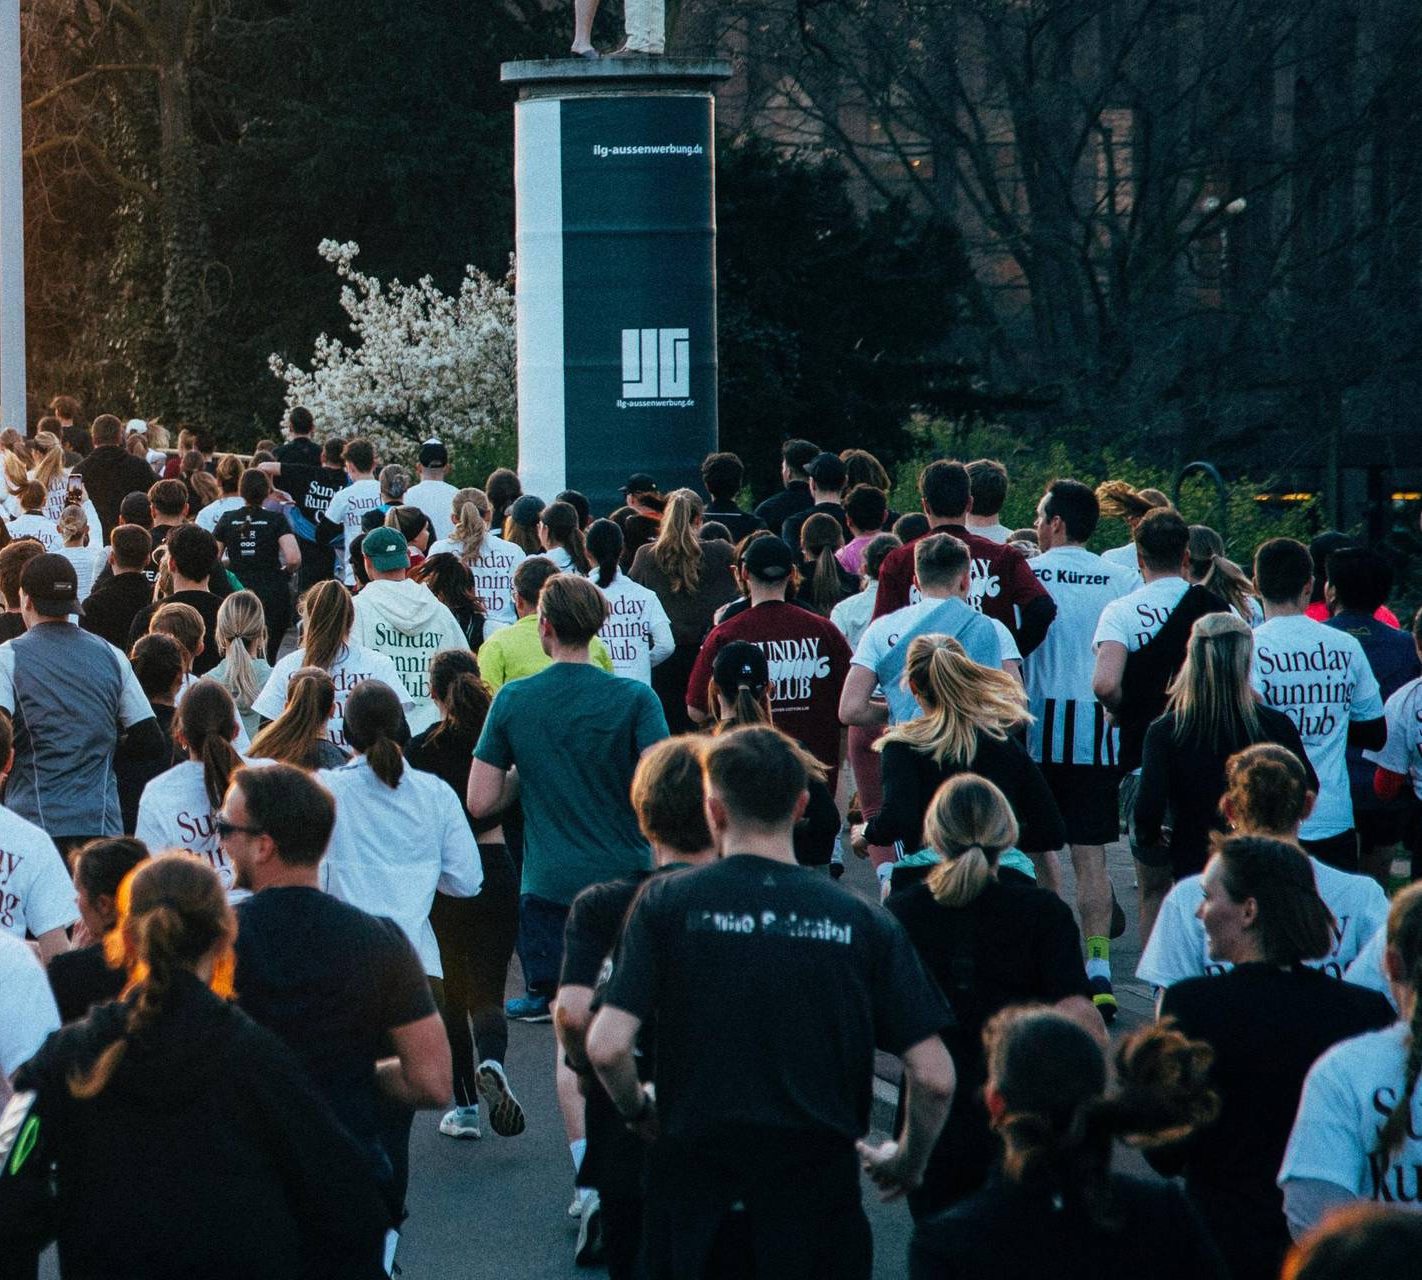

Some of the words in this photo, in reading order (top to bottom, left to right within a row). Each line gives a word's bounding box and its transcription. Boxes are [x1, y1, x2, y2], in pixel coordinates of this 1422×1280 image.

[347, 494, 383, 510] Sund
[1057, 570, 1110, 586] Kürzer
[597, 618, 652, 643] nning
[602, 639, 637, 661] lub
[1258, 641, 1353, 680] Sunday
